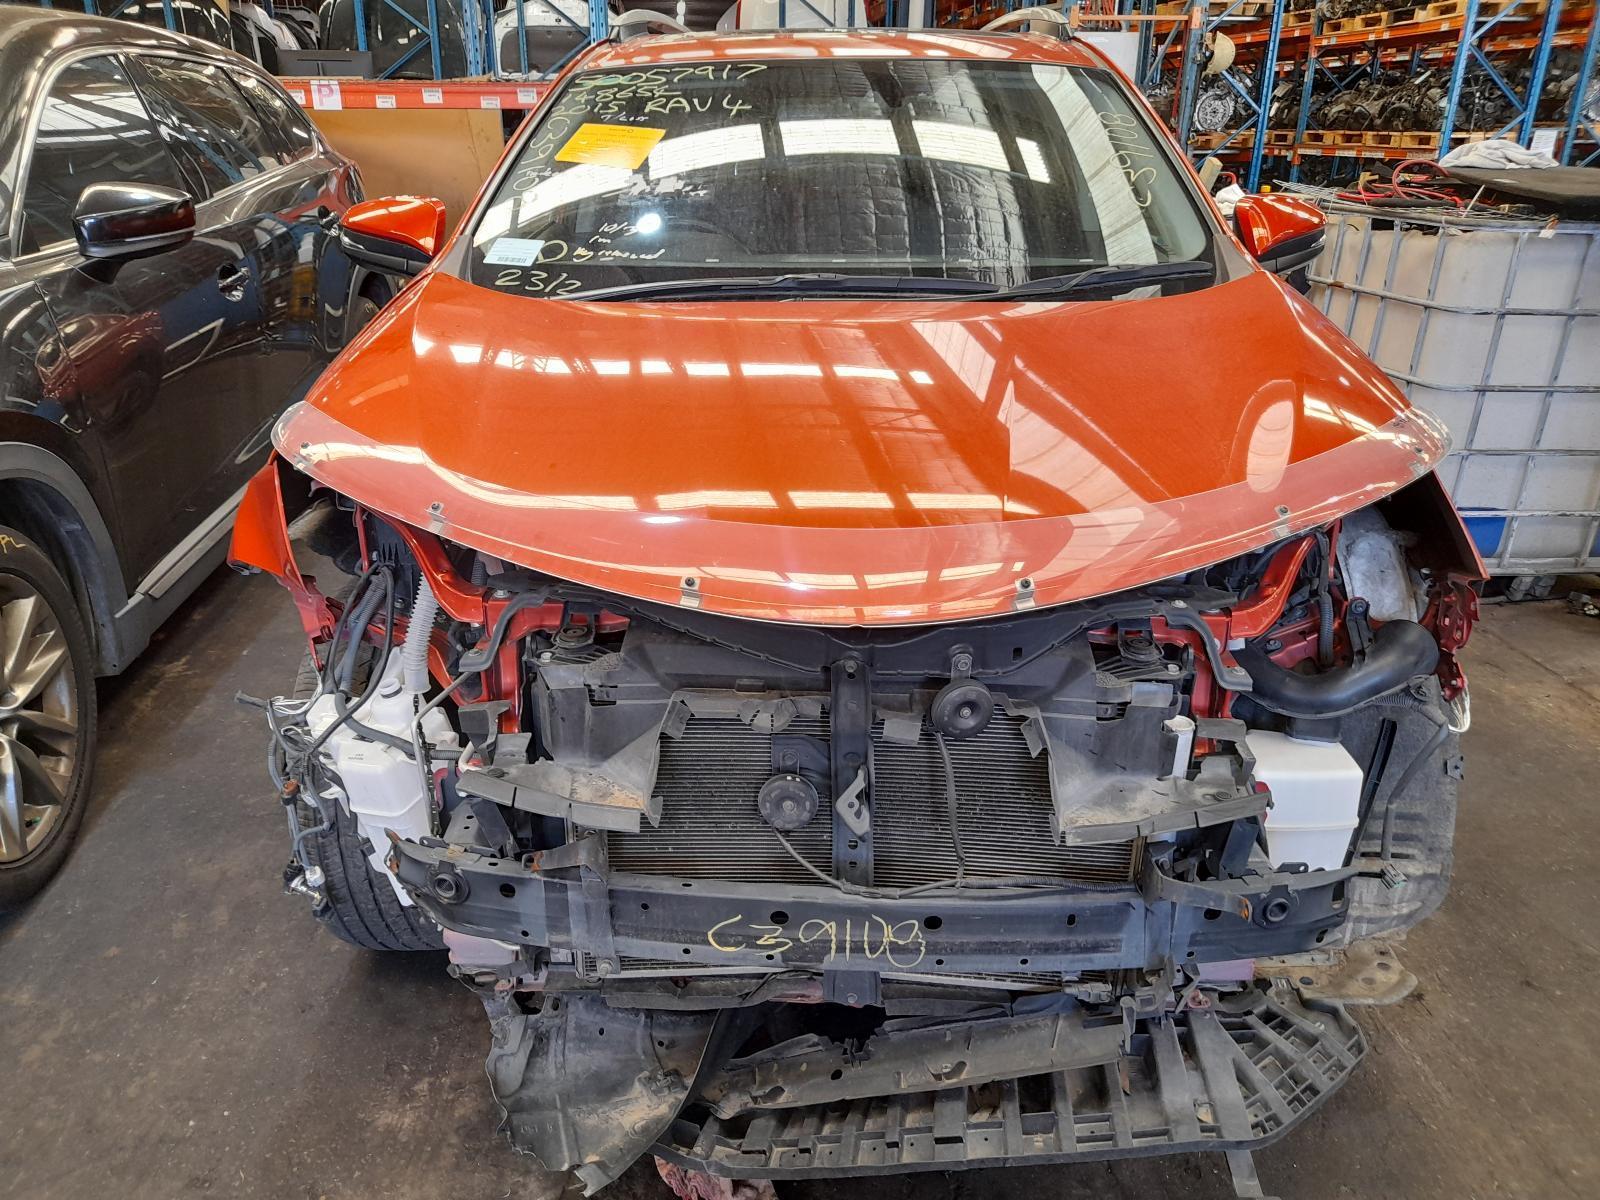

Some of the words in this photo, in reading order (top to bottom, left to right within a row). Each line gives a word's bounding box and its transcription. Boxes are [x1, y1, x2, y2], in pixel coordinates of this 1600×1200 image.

[569, 64, 768, 91] 50057917
[317, 84, 334, 106] P
[551, 101, 626, 117] 2015
[644, 97, 713, 114] RAV
[722, 94, 752, 119] 4
[1098, 111, 1157, 208] C39108
[494, 268, 582, 296] 23/2
[706, 913, 926, 969] C39108
